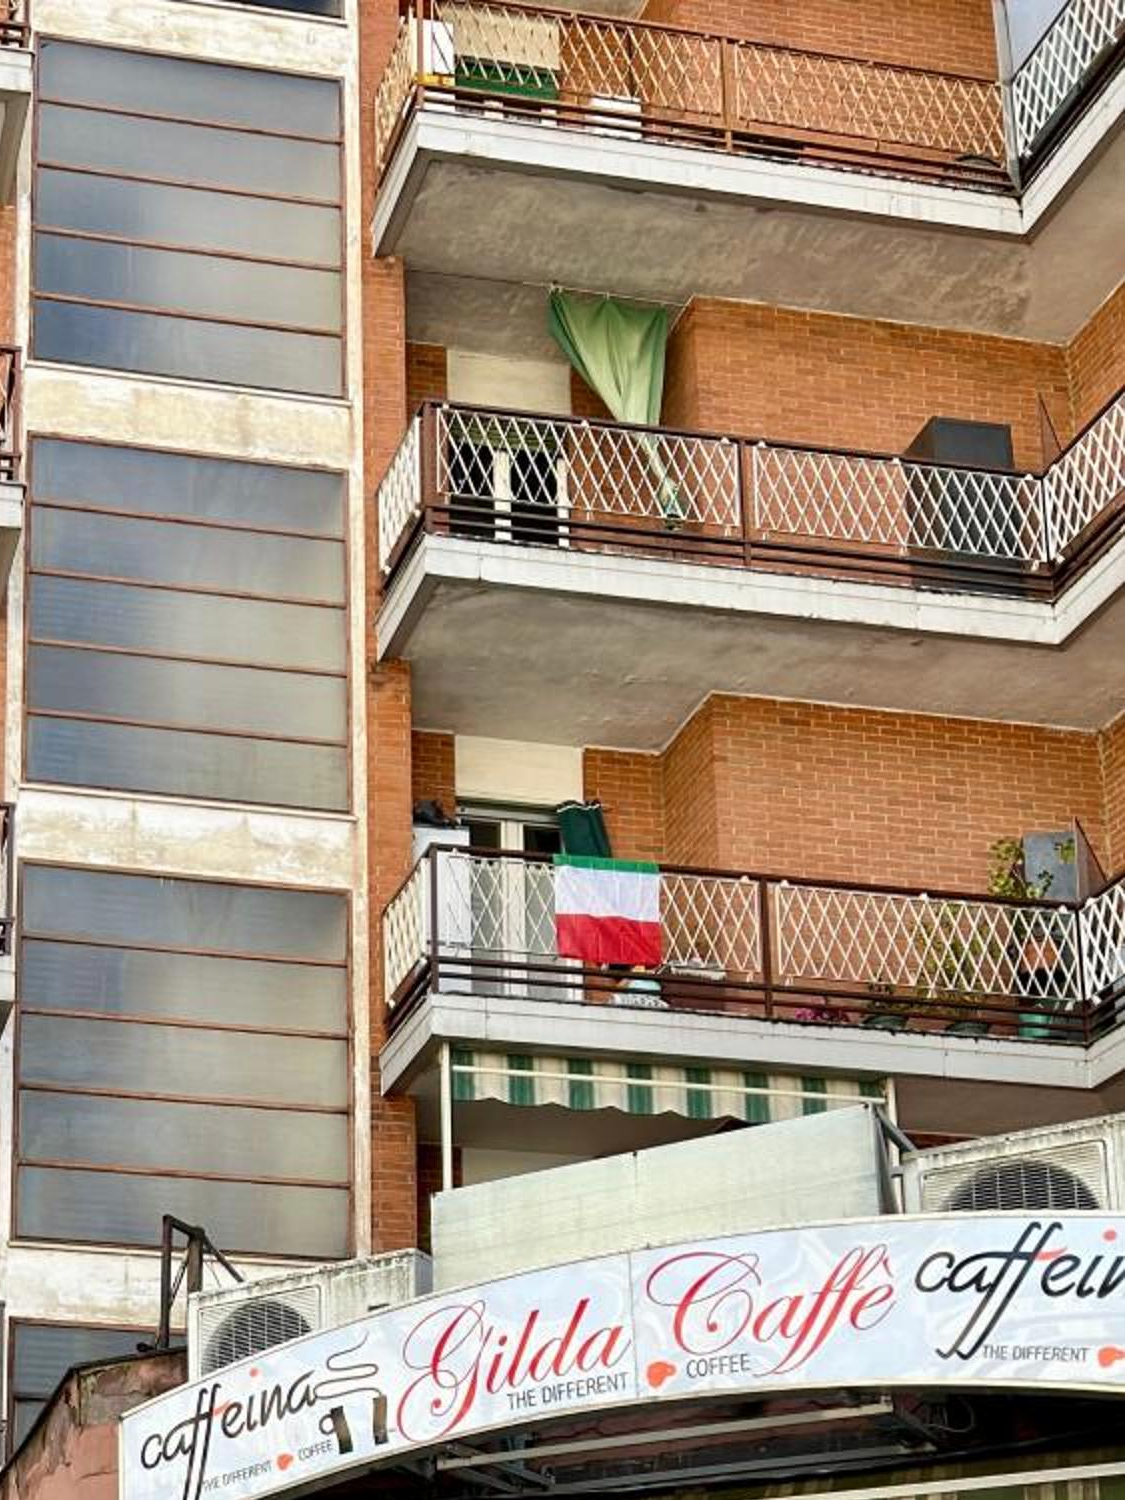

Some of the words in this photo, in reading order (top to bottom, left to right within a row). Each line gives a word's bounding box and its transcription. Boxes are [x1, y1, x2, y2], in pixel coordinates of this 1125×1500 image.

[396, 1297, 631, 1444] Gilda
[646, 1243, 897, 1377] Caffè
[983, 1344, 1008, 1360] THE
[1012, 1344, 1090, 1362] DIFFERENT
[506, 1387, 536, 1411] THE
[541, 1371, 630, 1405] DIFFERENT
[685, 1352, 751, 1379] COFFEE
[221, 1459, 273, 1487] DIFFERENT
[297, 1439, 333, 1461] COFFEE
